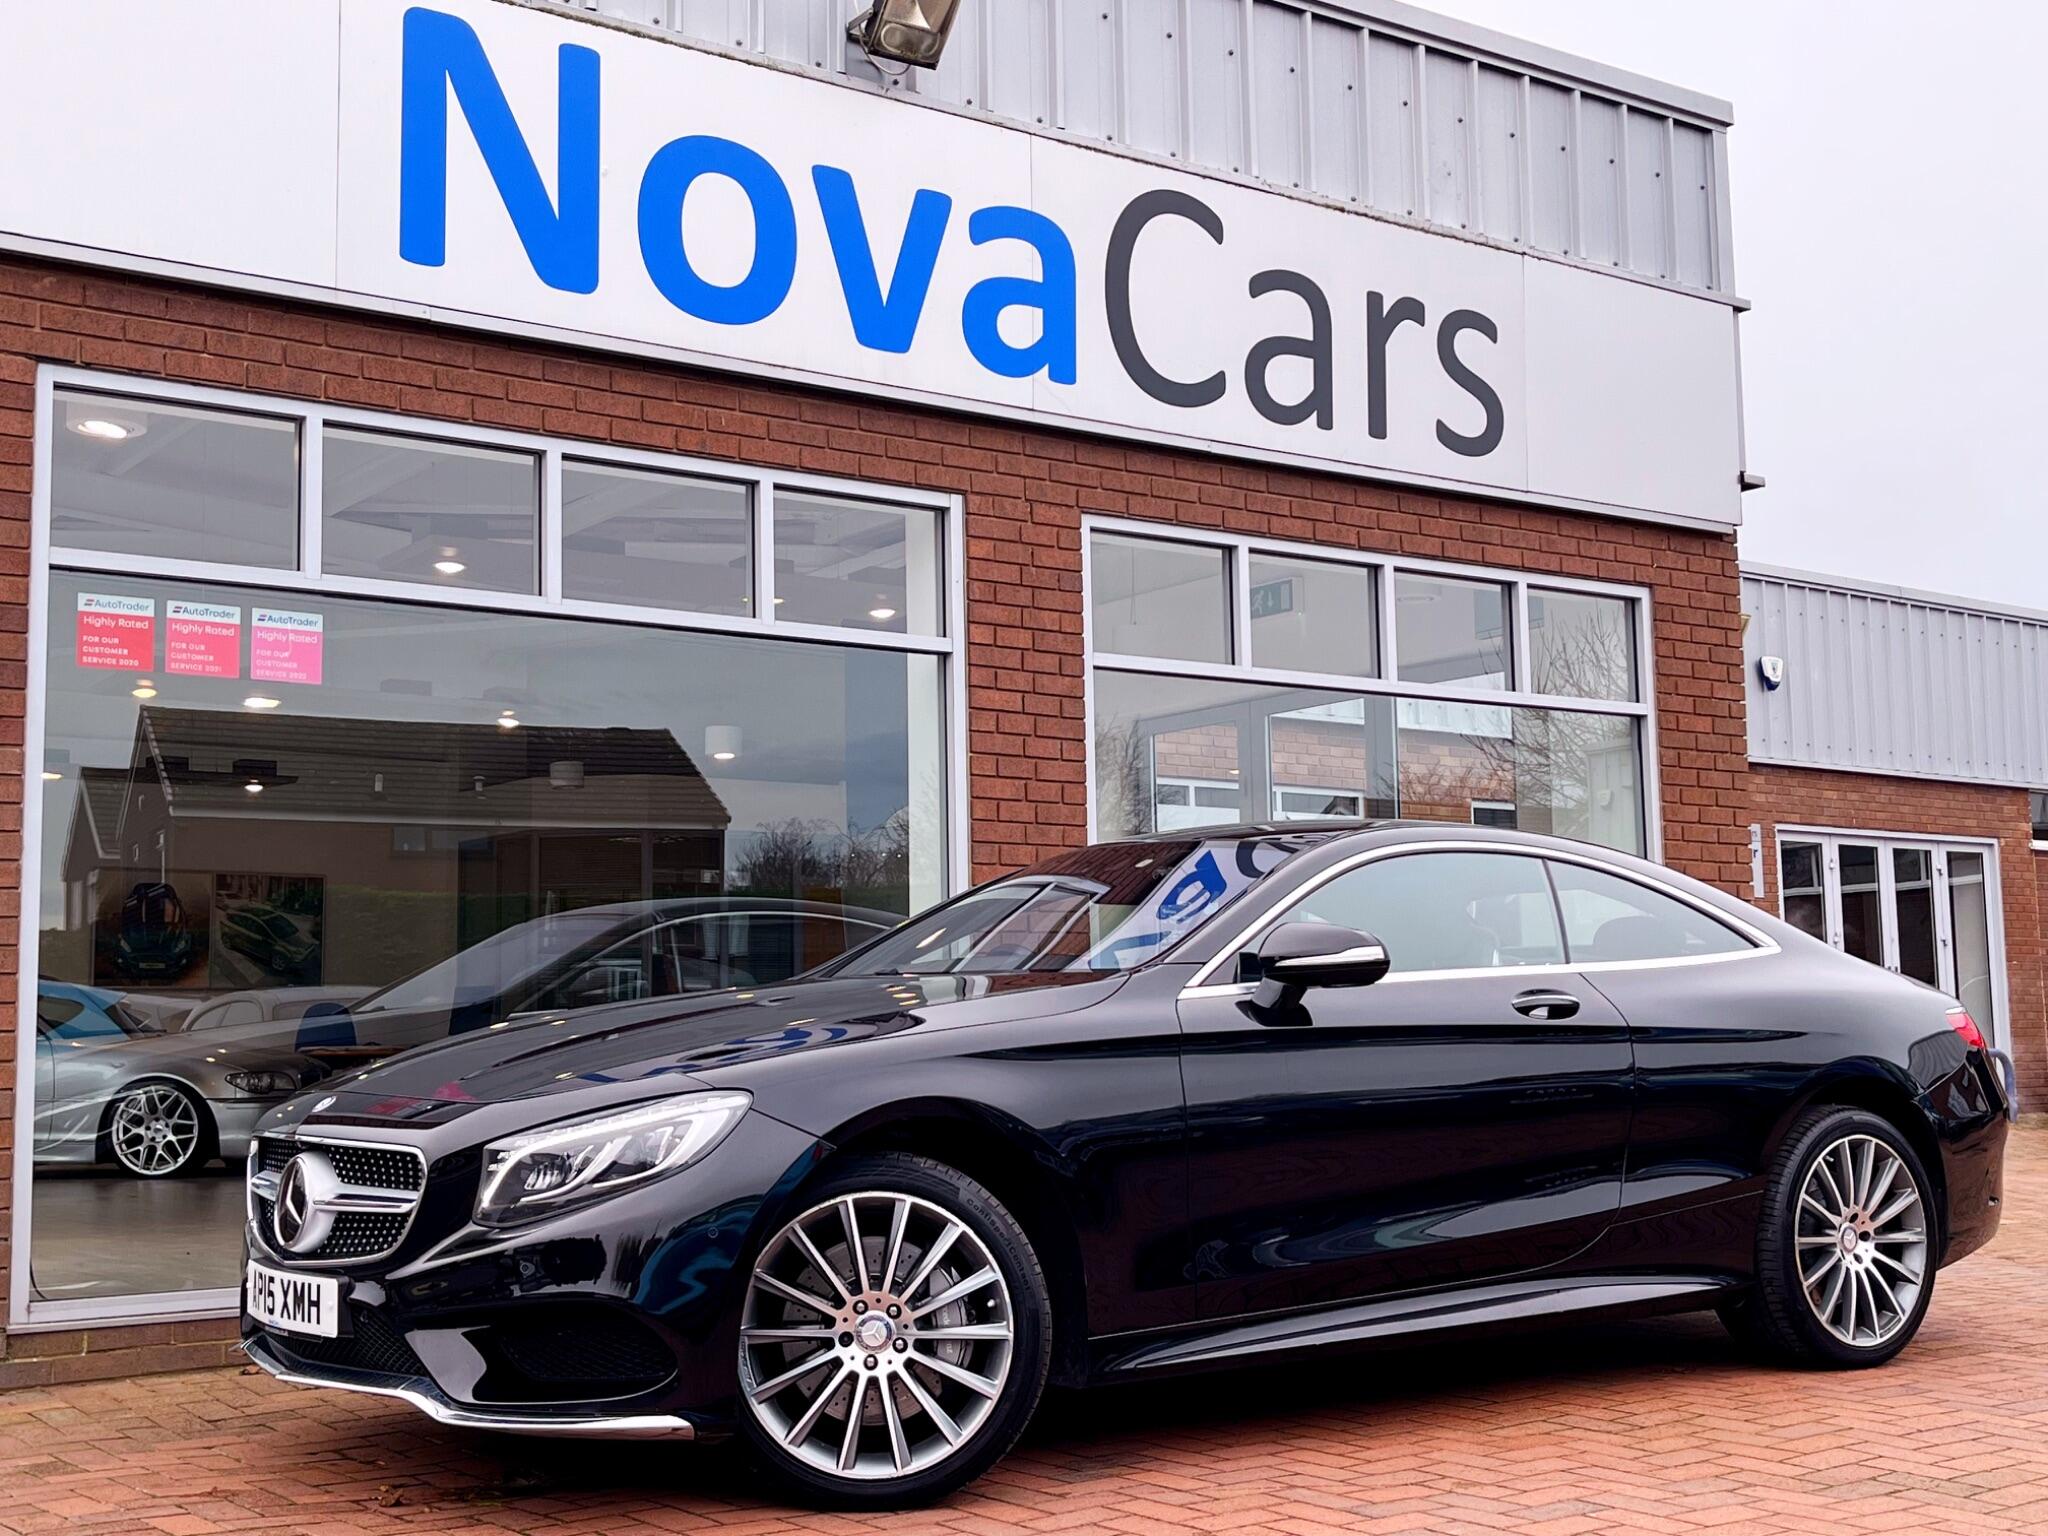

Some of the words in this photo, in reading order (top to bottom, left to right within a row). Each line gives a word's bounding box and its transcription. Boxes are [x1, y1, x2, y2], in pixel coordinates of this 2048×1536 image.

[400, 7, 1505, 457] NovaCars
[95, 600, 150, 612] AutoTrader
[182, 606, 236, 619] AutoTrader
[83, 616, 116, 629] Highly
[118, 618, 149, 629] Rated
[267, 616, 319, 628] AutoTrader
[171, 622, 203, 635] Highly
[204, 625, 235, 637] Rated
[82, 635, 100, 643] FOR
[101, 636, 119, 644] OUR
[256, 631, 288, 643] Highly
[288, 633, 318, 644] Rated
[82, 645, 129, 656] CUSTOMER
[170, 641, 187, 649] FOR
[188, 642, 206, 651] OUR
[82, 655, 117, 665] SERVICE
[118, 658, 139, 667] 2020
[170, 651, 214, 662] CUSTOMER
[170, 662, 203, 672] SERVICE
[252, 1269, 276, 1316] AP15
[280, 1278, 321, 1325] XMH
